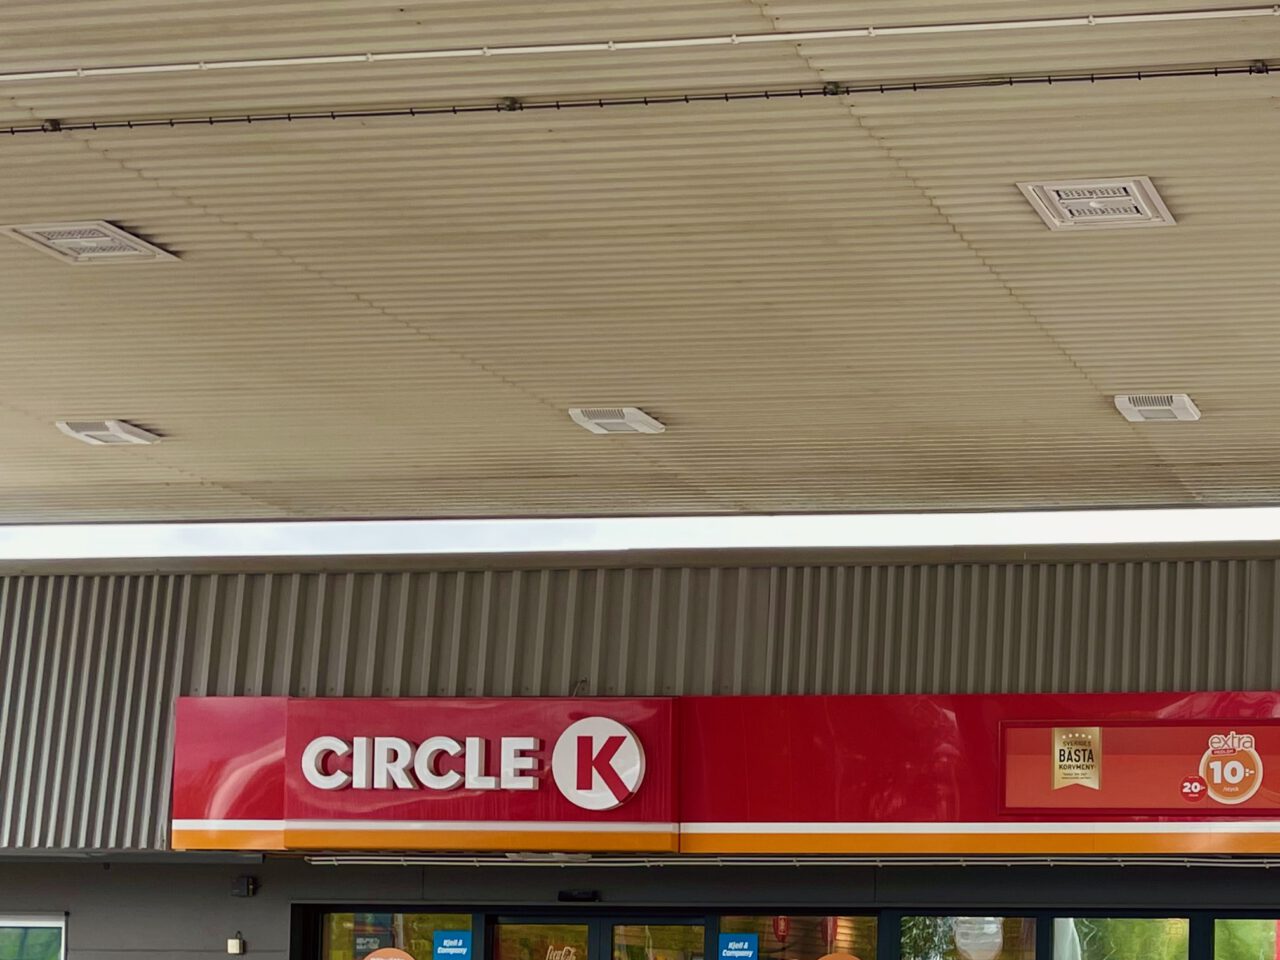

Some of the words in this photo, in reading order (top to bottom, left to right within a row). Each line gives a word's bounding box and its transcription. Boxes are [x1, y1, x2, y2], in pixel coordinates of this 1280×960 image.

[1209, 732, 1254, 750] extra
[1058, 747, 1094, 763] BÄSTA
[302, 735, 540, 791] CIRCLE
[567, 730, 634, 806] K
[437, 946, 467, 958] Company
[728, 941, 743, 950] Kjell
[722, 949, 753, 958] Company
